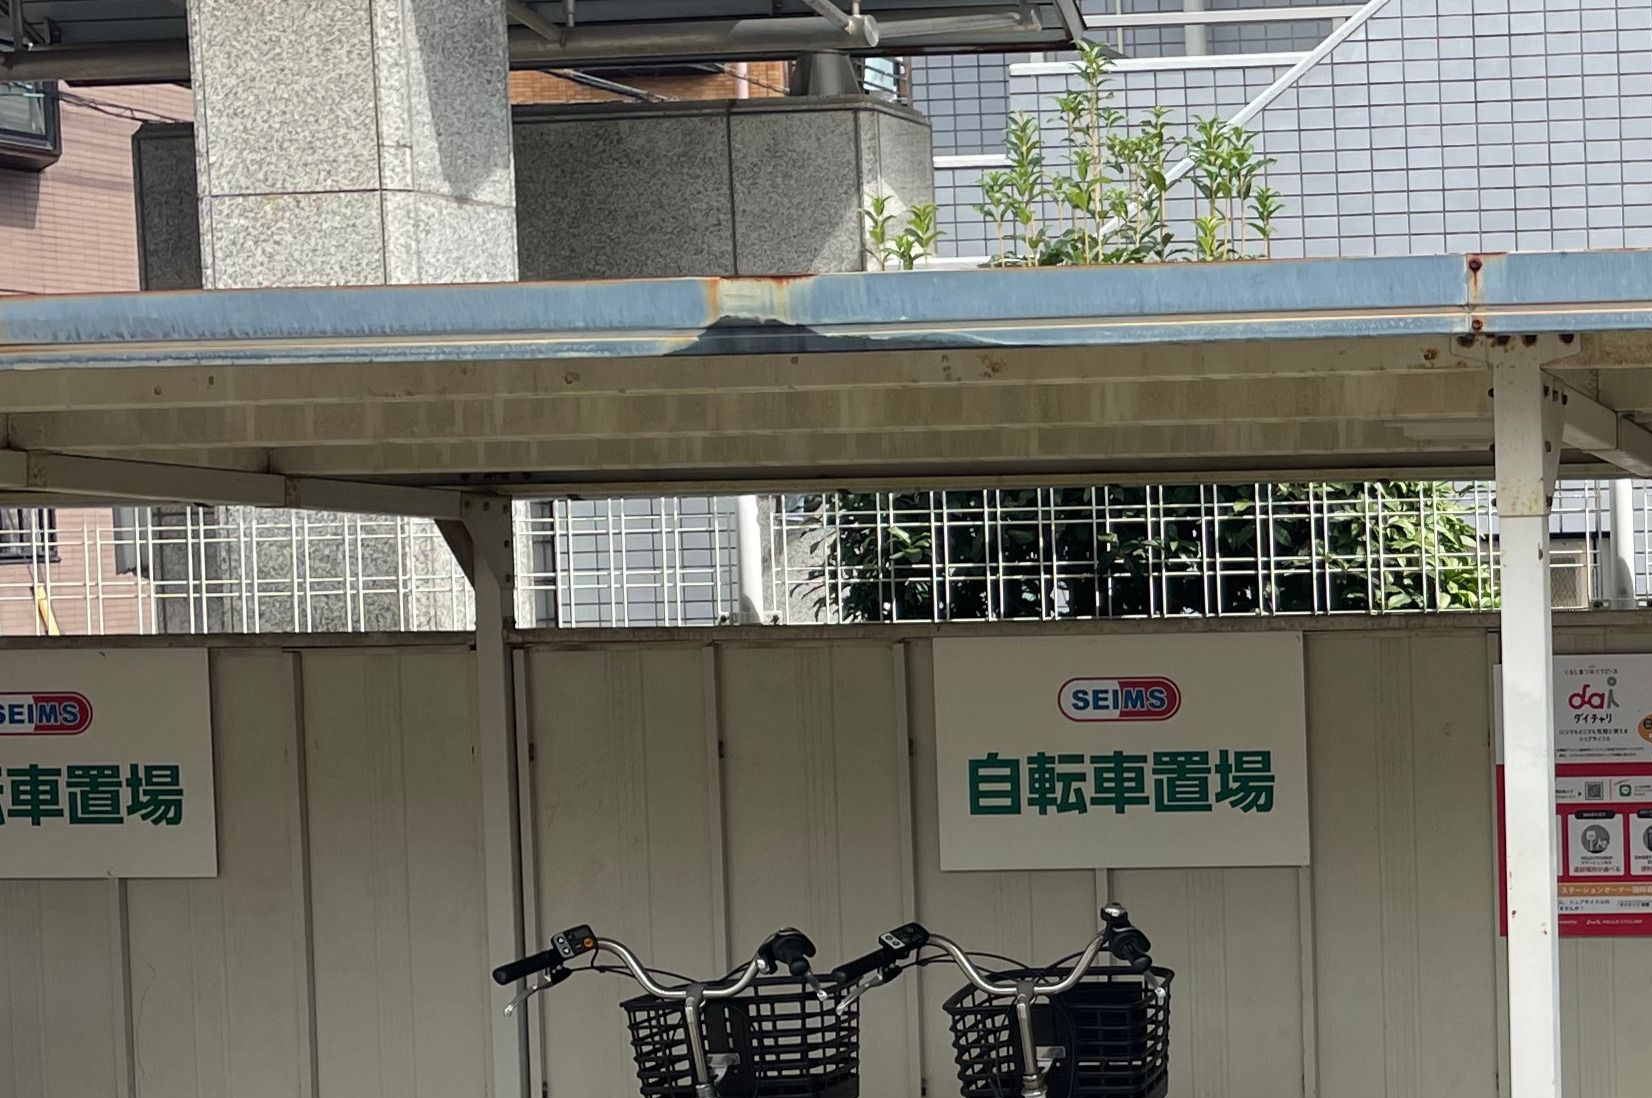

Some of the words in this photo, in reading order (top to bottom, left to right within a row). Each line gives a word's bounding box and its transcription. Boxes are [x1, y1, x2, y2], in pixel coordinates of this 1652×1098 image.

[1070, 687, 1170, 712] SEIMS
[1568, 676, 1620, 710] dai
[0, 703, 80, 726] EIMS
[1573, 712, 1613, 725] ダイチャリ
[0, 762, 185, 827] 車置場
[967, 749, 1276, 816] 自転車置場
